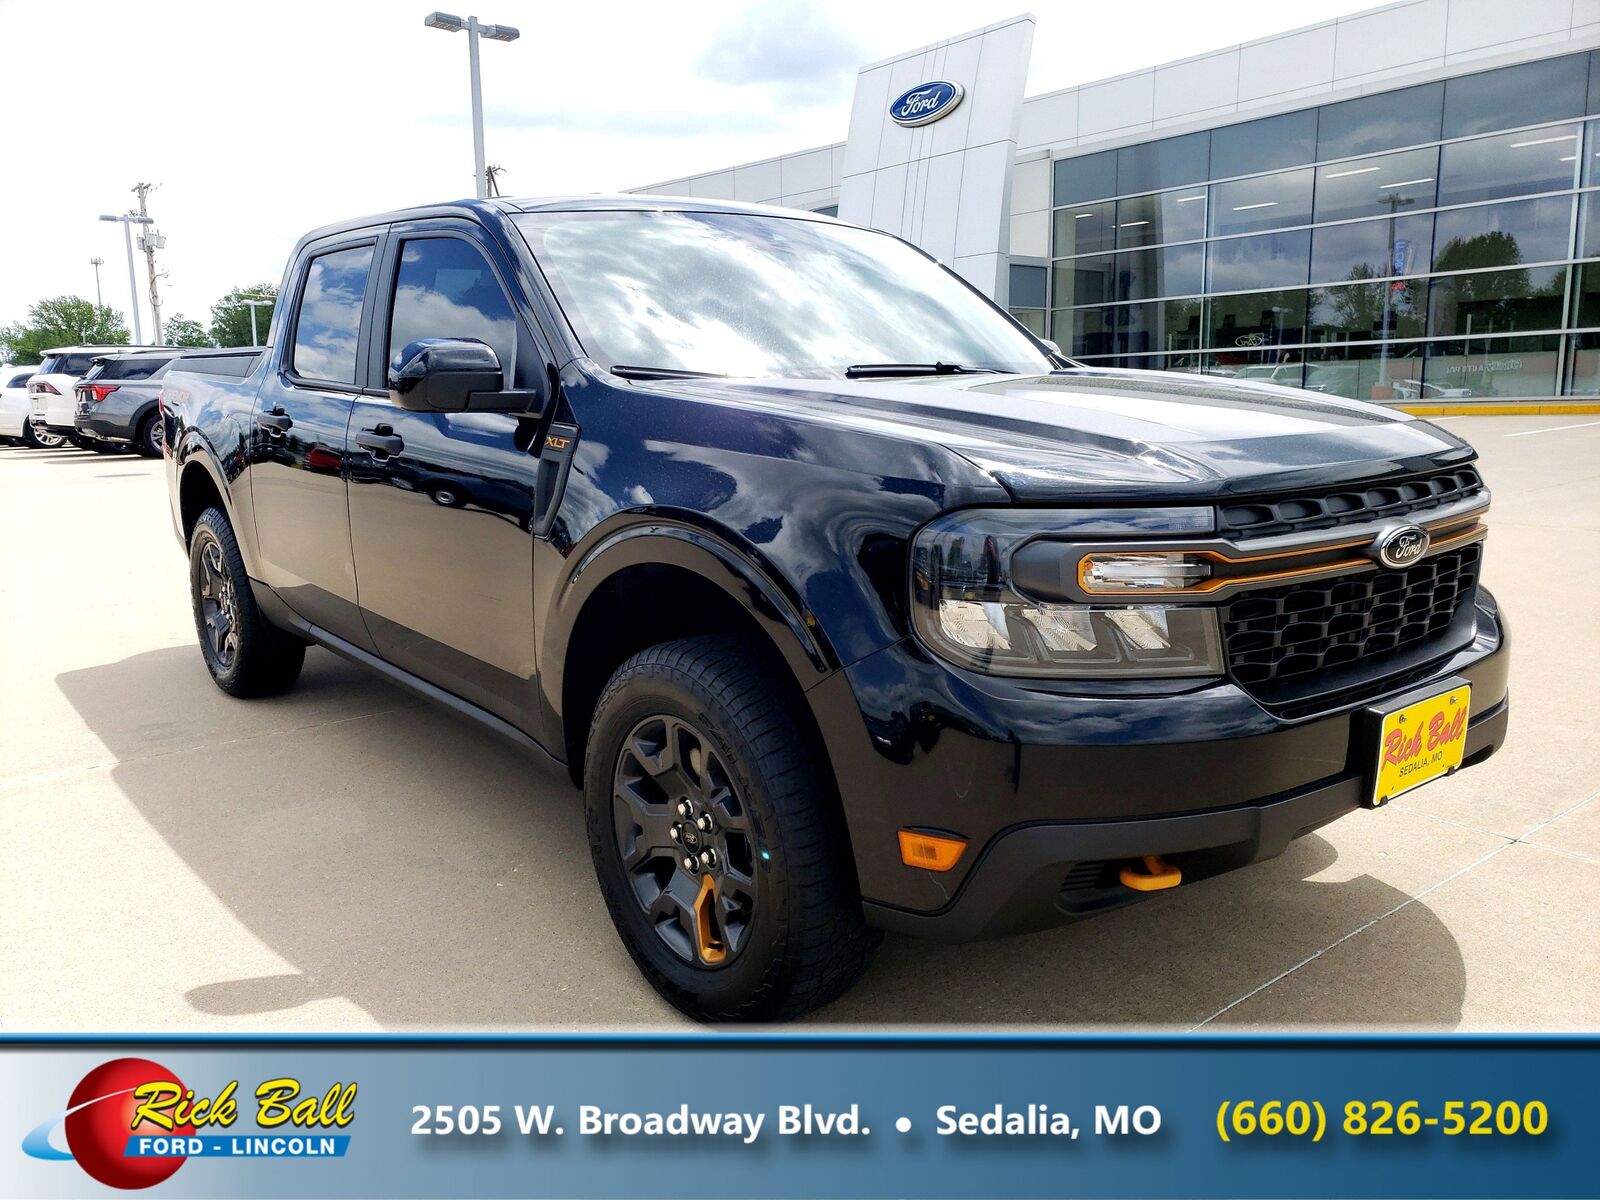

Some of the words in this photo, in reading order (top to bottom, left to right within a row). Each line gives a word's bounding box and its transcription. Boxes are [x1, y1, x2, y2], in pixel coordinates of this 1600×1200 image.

[901, 89, 941, 116] Ford
[545, 436, 570, 449] XLT
[1395, 535, 1422, 559] Ford
[1381, 721, 1424, 771] Rick
[1427, 705, 1467, 751] Ball
[1399, 757, 1430, 777] SEDALIA,
[1431, 750, 1443, 763] MO
